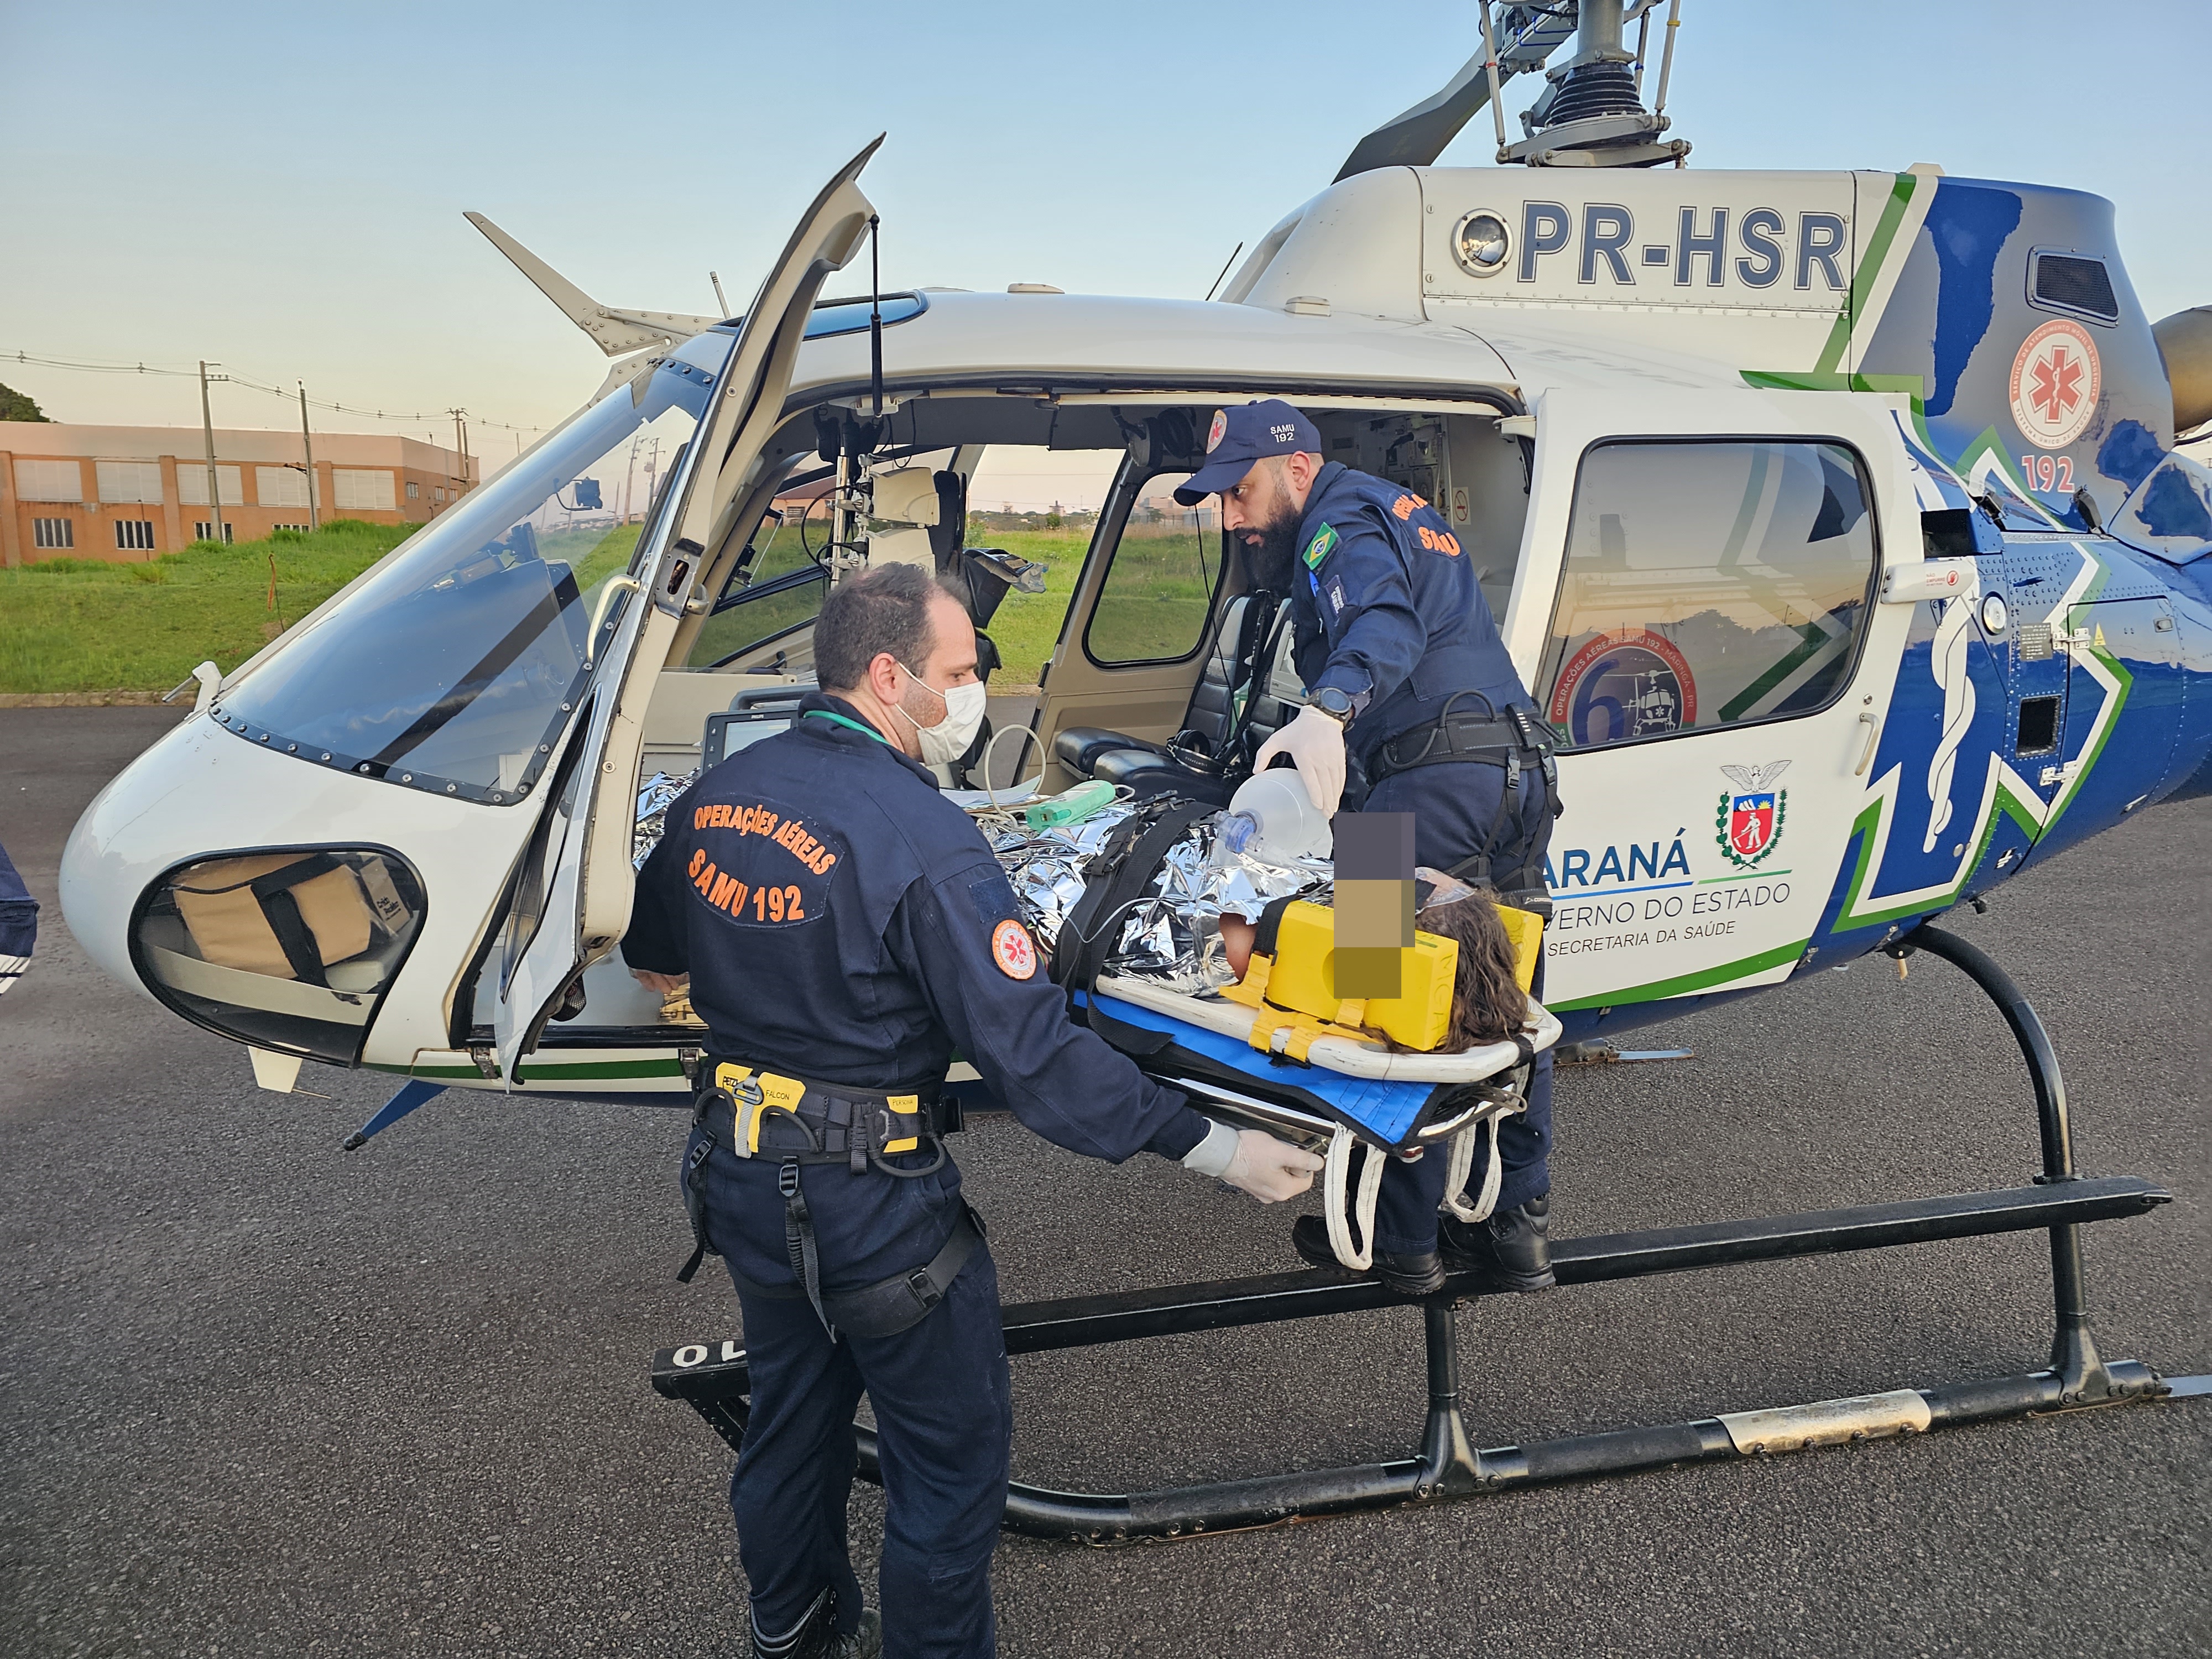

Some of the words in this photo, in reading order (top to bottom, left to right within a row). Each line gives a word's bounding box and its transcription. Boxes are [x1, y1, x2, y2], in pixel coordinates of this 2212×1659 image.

[1517, 199, 1848, 291] PR-HSR
[2013, 360, 2022, 394] SERVIÇO
[2021, 349, 2029, 358] DE
[2028, 325, 2070, 347] ATENDIMENTO
[2071, 327, 2088, 346] MÓVEL
[2086, 346, 2093, 355] DE
[1270, 424, 1295, 434] SAMU
[1275, 432, 1294, 442] 192
[2016, 408, 2036, 439] SISTEMA
[2021, 454, 2075, 493] 192
[1418, 526, 1460, 556] SAU
[1556, 658, 1586, 716] OPERAÇÕES
[1586, 637, 1619, 660] AÉREAS
[1621, 634, 1645, 644] SAMU
[1647, 638, 1661, 649] 192
[1665, 649, 1689, 688] MARINGÁ
[694, 805, 778, 836] OPERAÇÕES
[771, 820, 836, 875] AÉREAS
[1543, 827, 1691, 889] ARANÁ
[688, 848, 749, 917] SAMU
[753, 885, 805, 922] 192
[1645, 896, 1683, 920] DO
[1692, 883, 1790, 915] ESTADO
[1548, 932, 1649, 957] SECRETARIA
[1656, 929, 1677, 942] DA
[1684, 920, 1735, 939] SAÚDE
[723, 1076, 738, 1087] PETZ
[766, 1089, 790, 1100] FALCON
